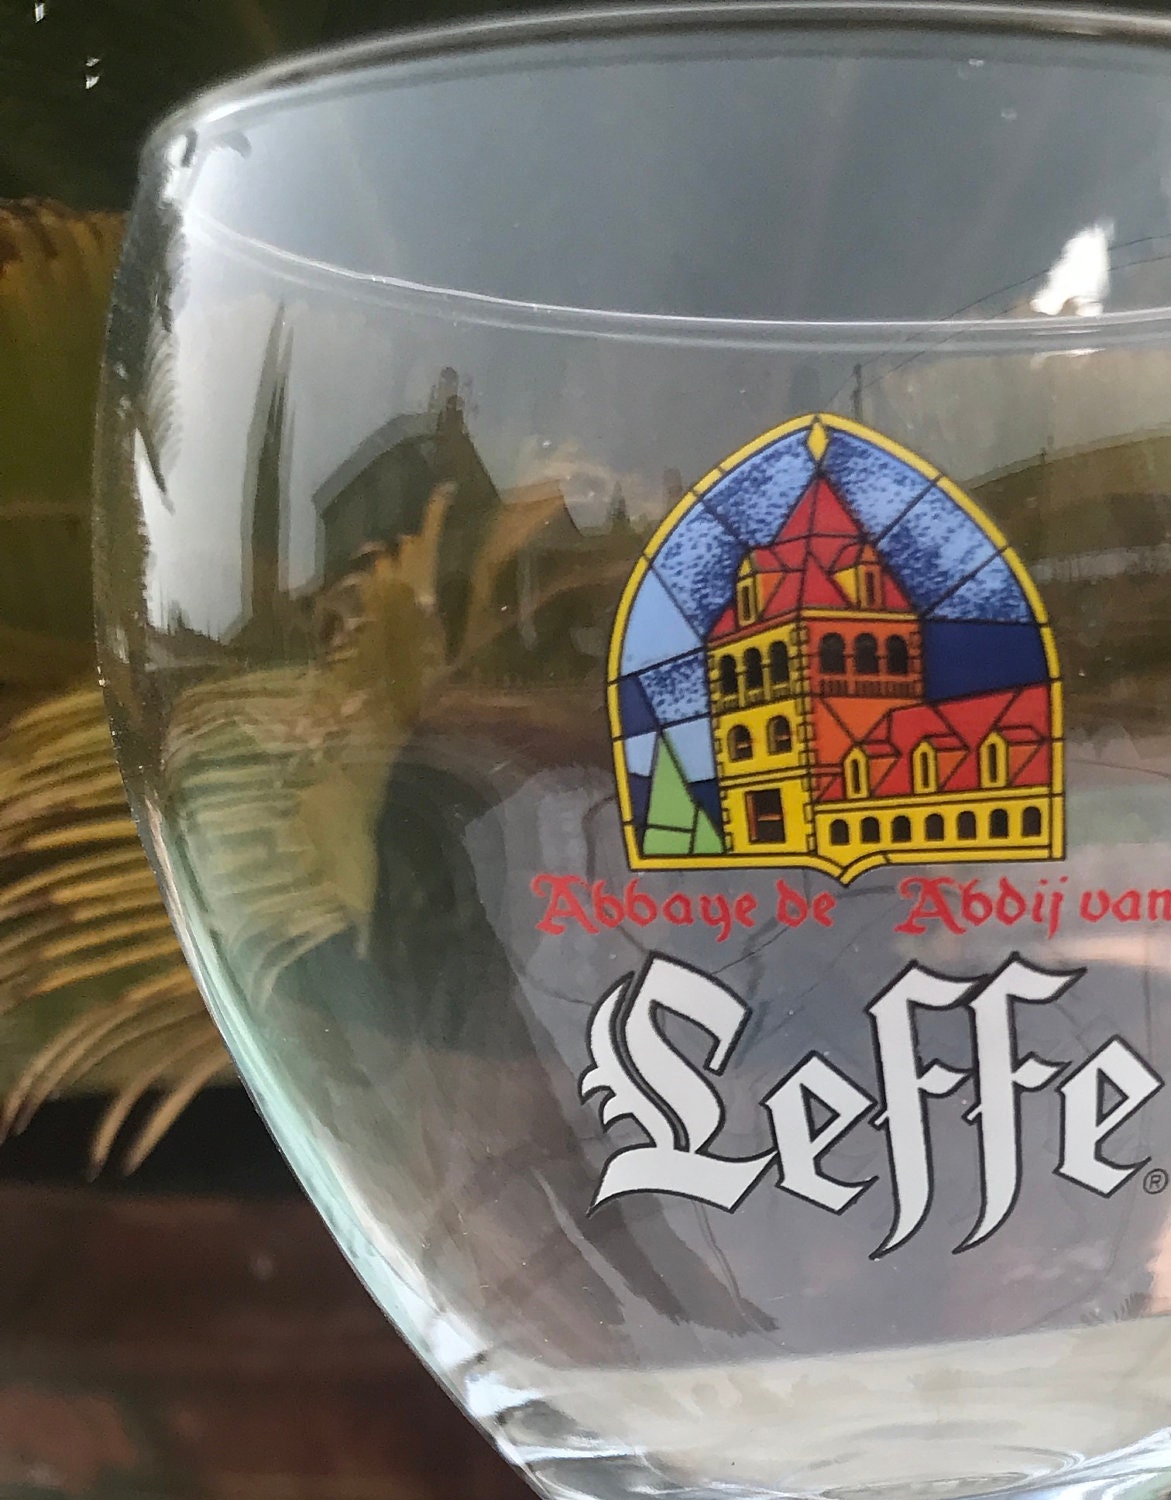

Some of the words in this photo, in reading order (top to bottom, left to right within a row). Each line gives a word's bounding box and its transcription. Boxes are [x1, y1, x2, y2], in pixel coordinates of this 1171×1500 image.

[530, 873, 757, 942] Abbaye
[776, 879, 836, 927] de
[894, 876, 1068, 939] Abdij
[580, 951, 1165, 1259] Leffe
